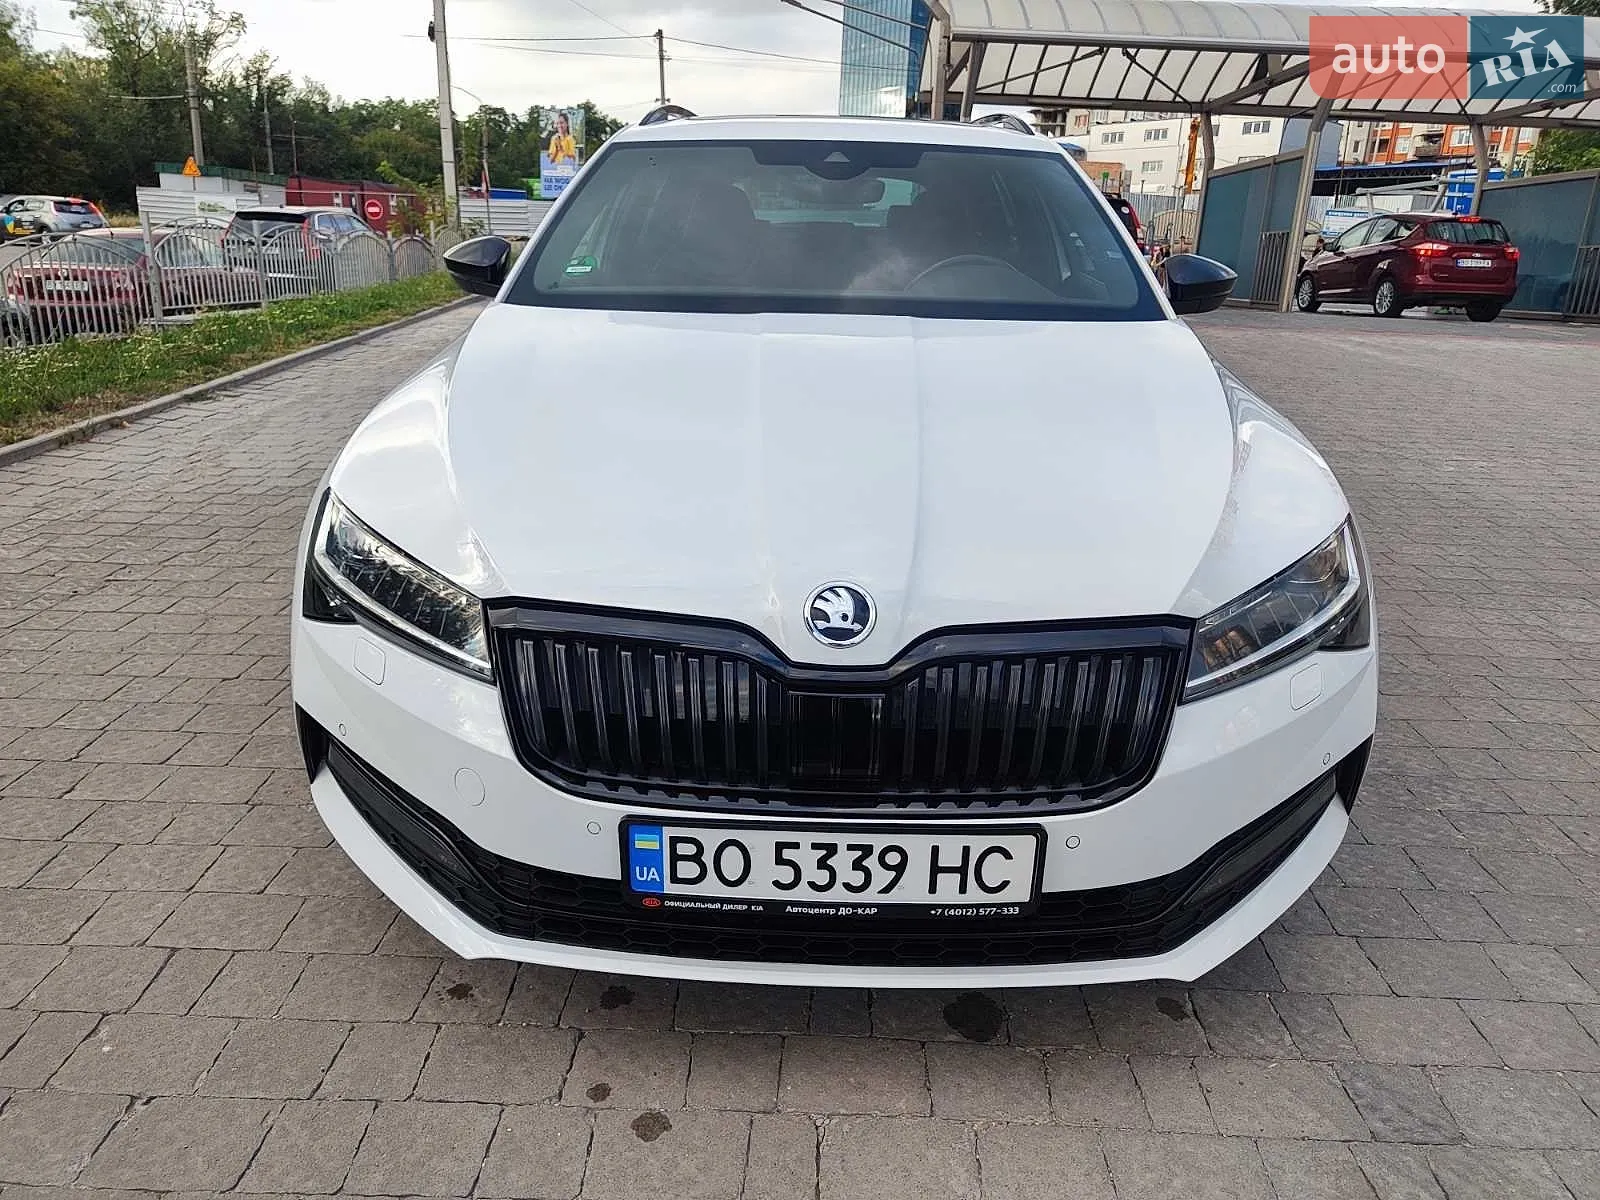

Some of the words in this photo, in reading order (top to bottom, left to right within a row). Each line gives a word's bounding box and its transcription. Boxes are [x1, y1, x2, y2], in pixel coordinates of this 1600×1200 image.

[669, 836, 751, 888] BO
[772, 841, 909, 894] 5339
[928, 845, 1014, 895] HC
[635, 866, 660, 882] UA
[722, 903, 748, 911] ДИЛЕР
[785, 905, 836, 917] Автоцентр
[838, 906, 878, 917] ДО-КАР
[930, 907, 943, 917] +7
[944, 906, 977, 917] (4012)
[978, 906, 1020, 917] 577-333
